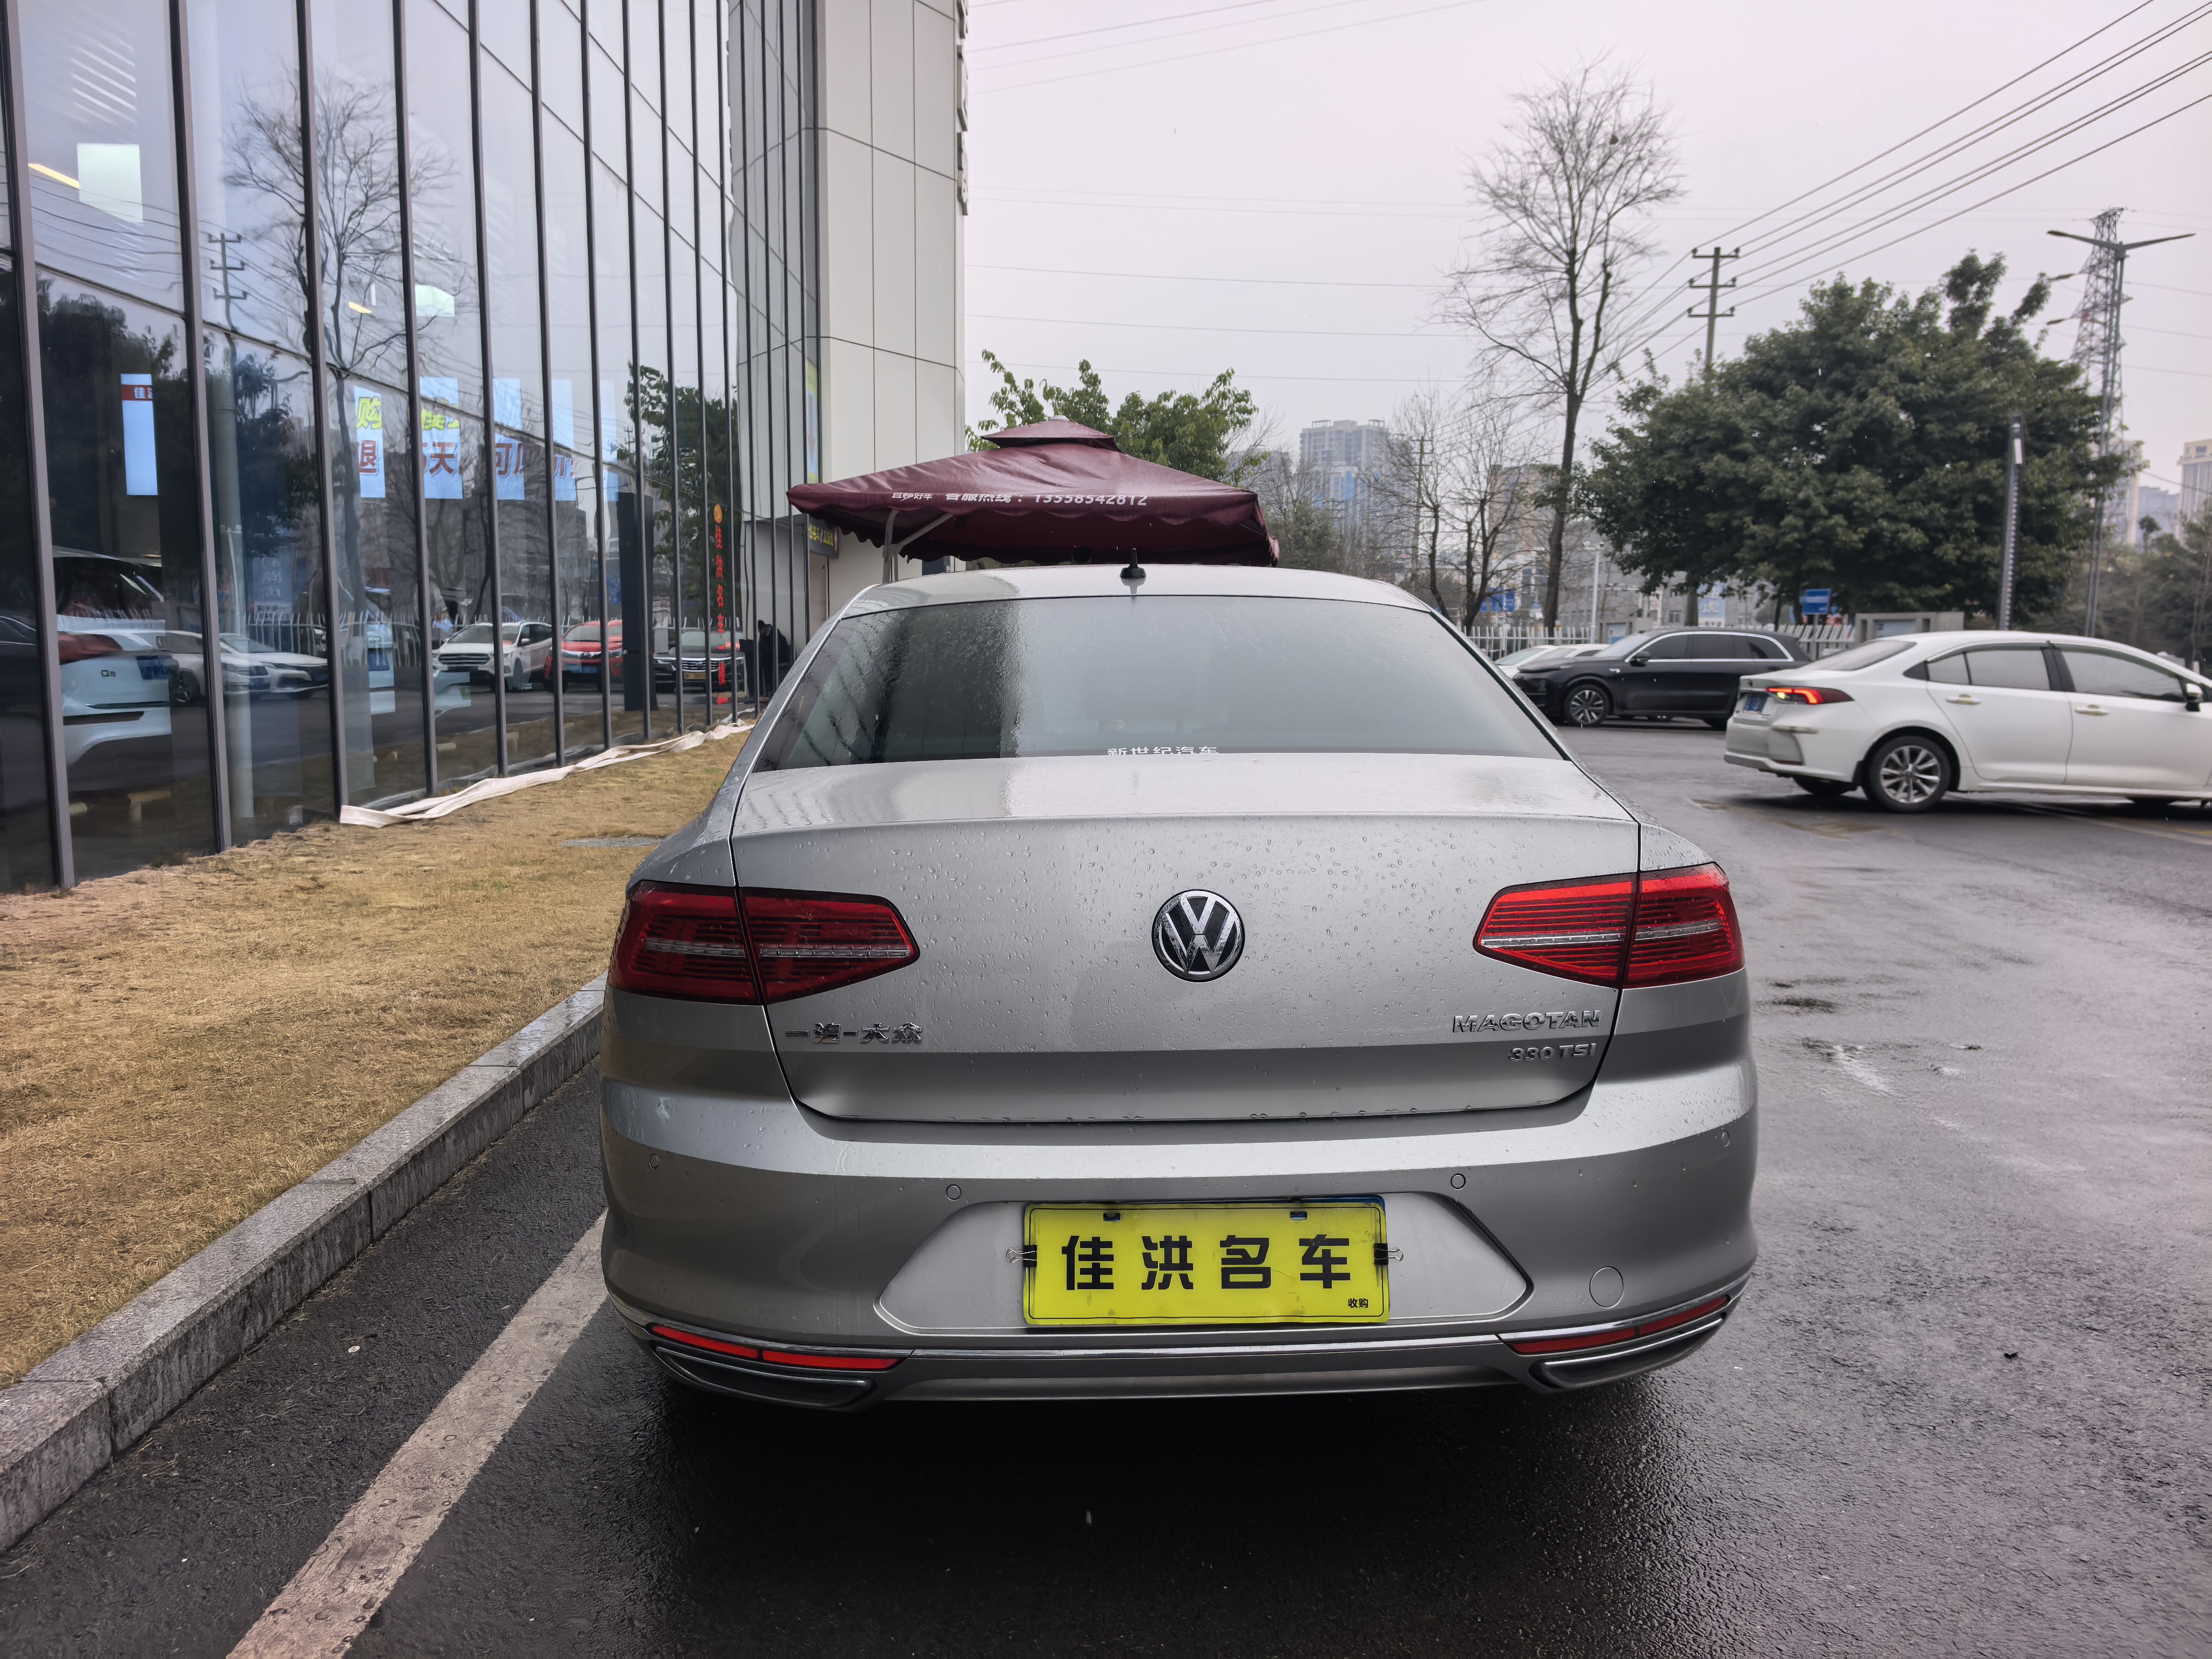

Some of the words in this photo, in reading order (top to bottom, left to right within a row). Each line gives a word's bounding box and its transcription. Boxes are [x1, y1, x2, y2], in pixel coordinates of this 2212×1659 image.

[1107, 746, 1219, 756] 新世纪汽车
[1453, 1010, 1600, 1033] MAGOTAN
[1508, 1046, 1555, 1062] 330
[1559, 1043, 1596, 1058] TSI
[1061, 1234, 1351, 1290] 佳洪名车
[1348, 1298, 1368, 1309] 收购
